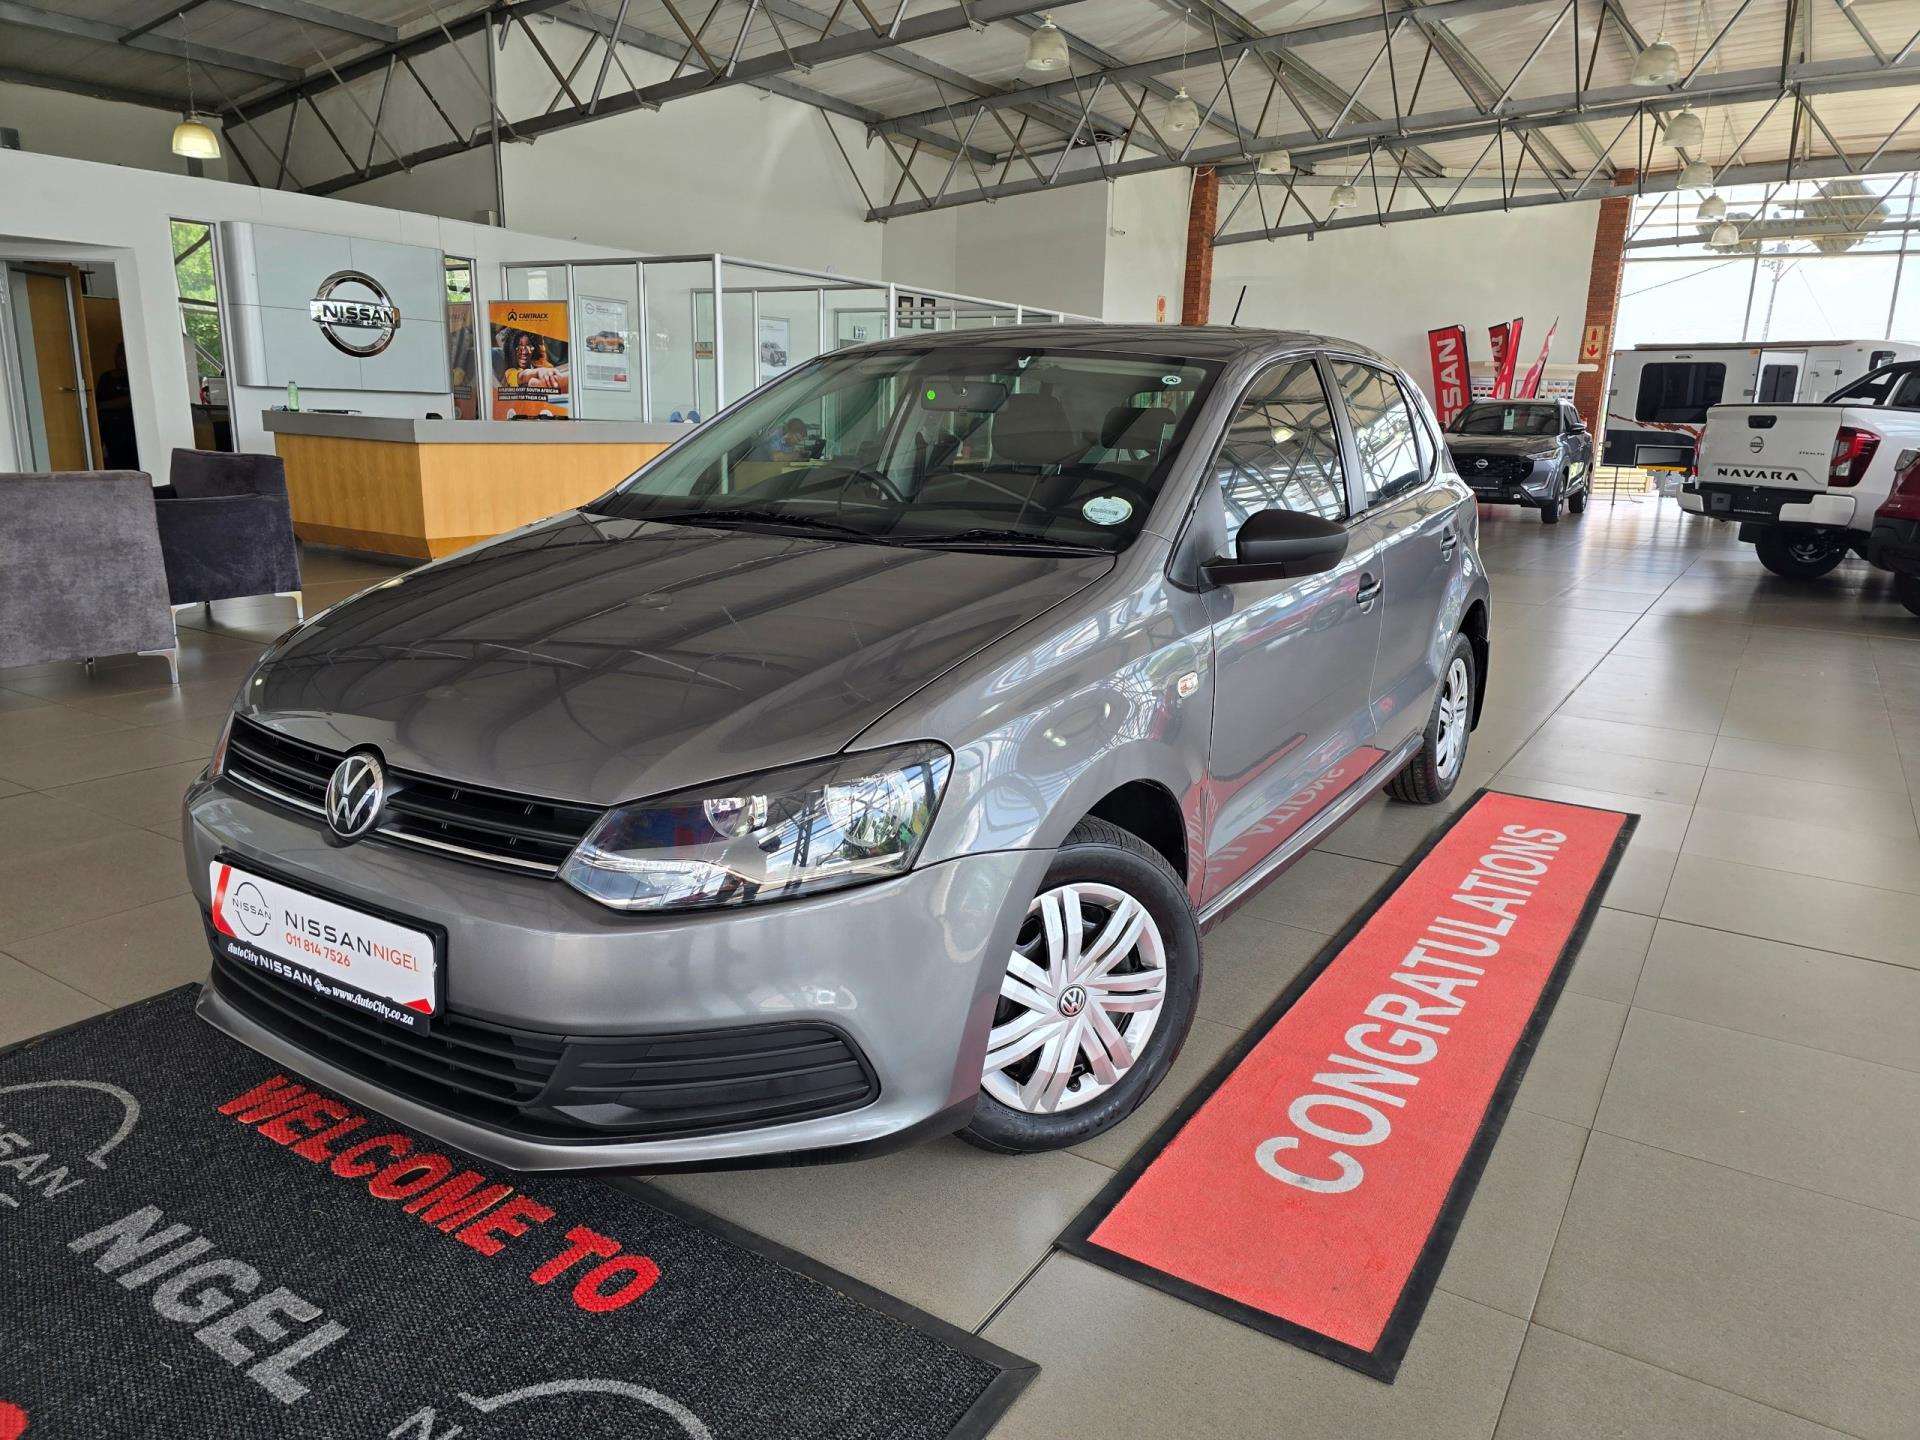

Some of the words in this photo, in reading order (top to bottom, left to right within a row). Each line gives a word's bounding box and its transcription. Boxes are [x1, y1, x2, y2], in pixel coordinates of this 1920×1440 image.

[322, 304, 394, 323] NISSAN
[518, 312, 549, 320] CARTRACK
[1717, 467, 1799, 482] NAVARA
[231, 897, 272, 921] NISSAN
[285, 932, 302, 948] 011
[303, 939, 321, 955] 814
[323, 946, 351, 967] 7526
[259, 954, 312, 987] NISSAN
[331, 985, 415, 1026] www.AutoCity.co.za
[1254, 823, 1568, 1194] CONGRATULATIONS
[217, 1074, 557, 1257] WELCOME
[528, 1223, 662, 1313] TO
[67, 1204, 351, 1404] NIGEL
